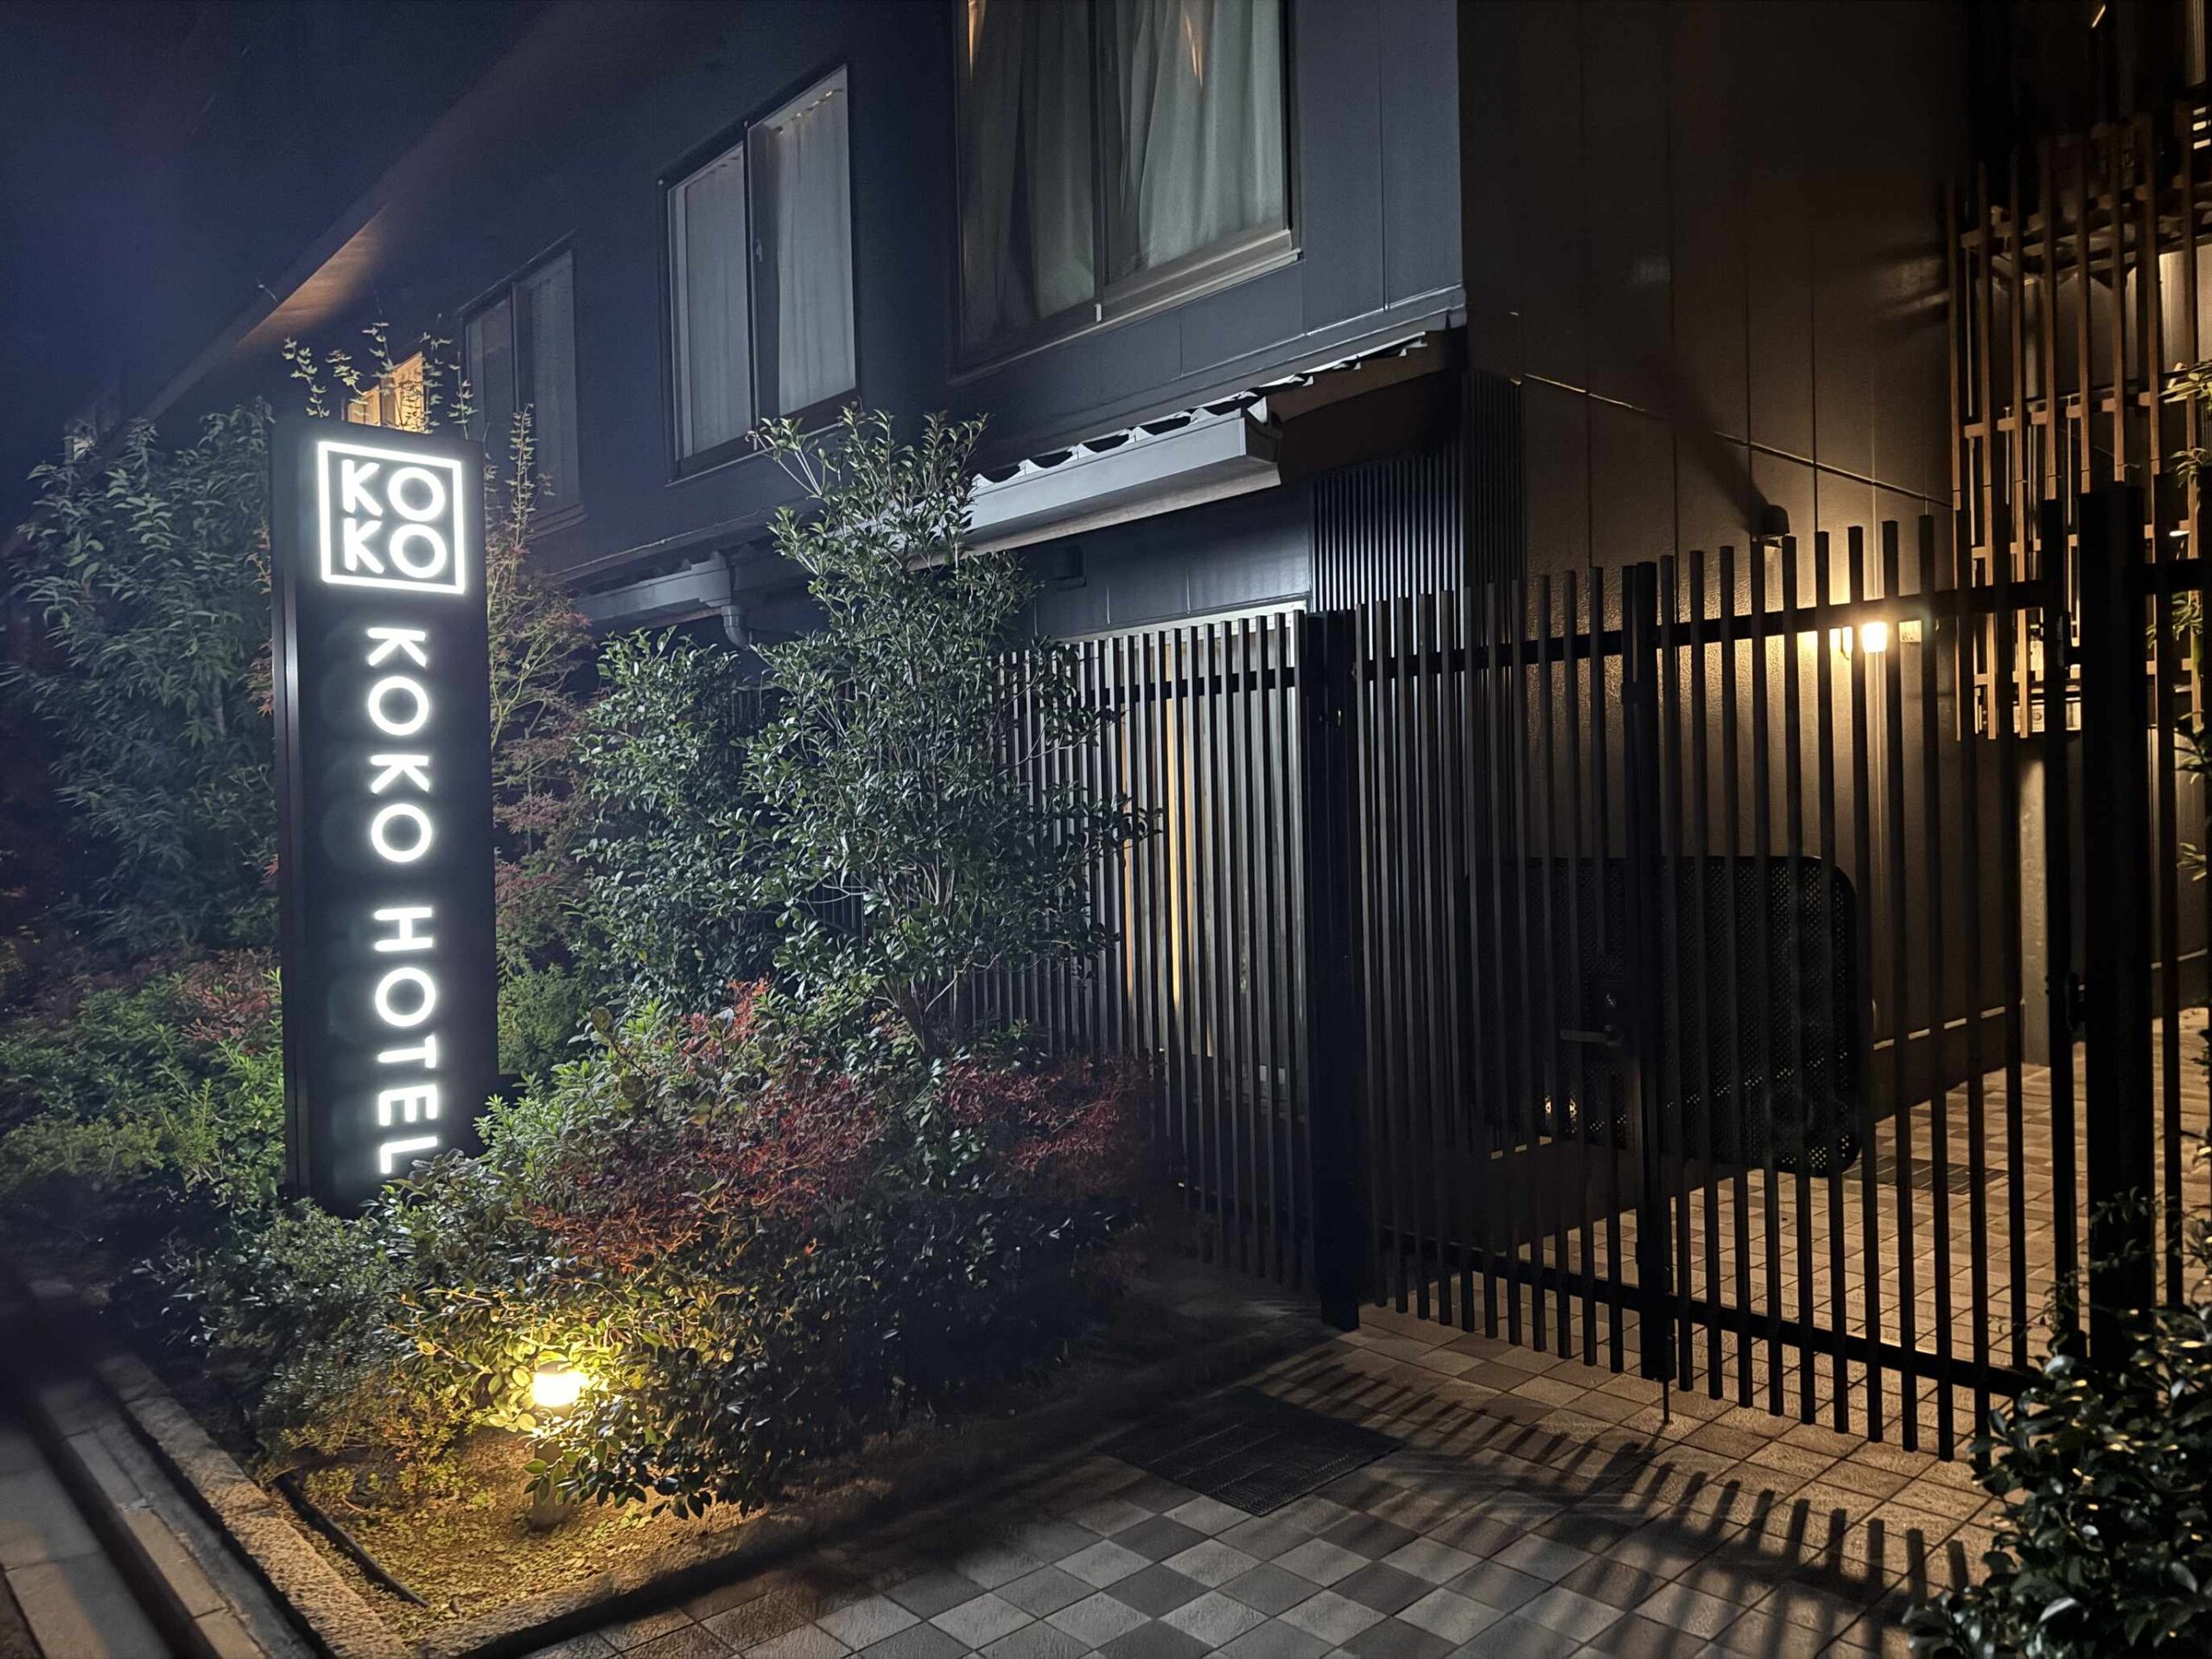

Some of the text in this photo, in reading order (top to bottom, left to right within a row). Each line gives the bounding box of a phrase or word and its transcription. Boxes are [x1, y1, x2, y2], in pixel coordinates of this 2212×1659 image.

[340, 458, 446, 522] KO
[342, 517, 448, 579] KO
[366, 626, 440, 1175] KOKO HOTEL
